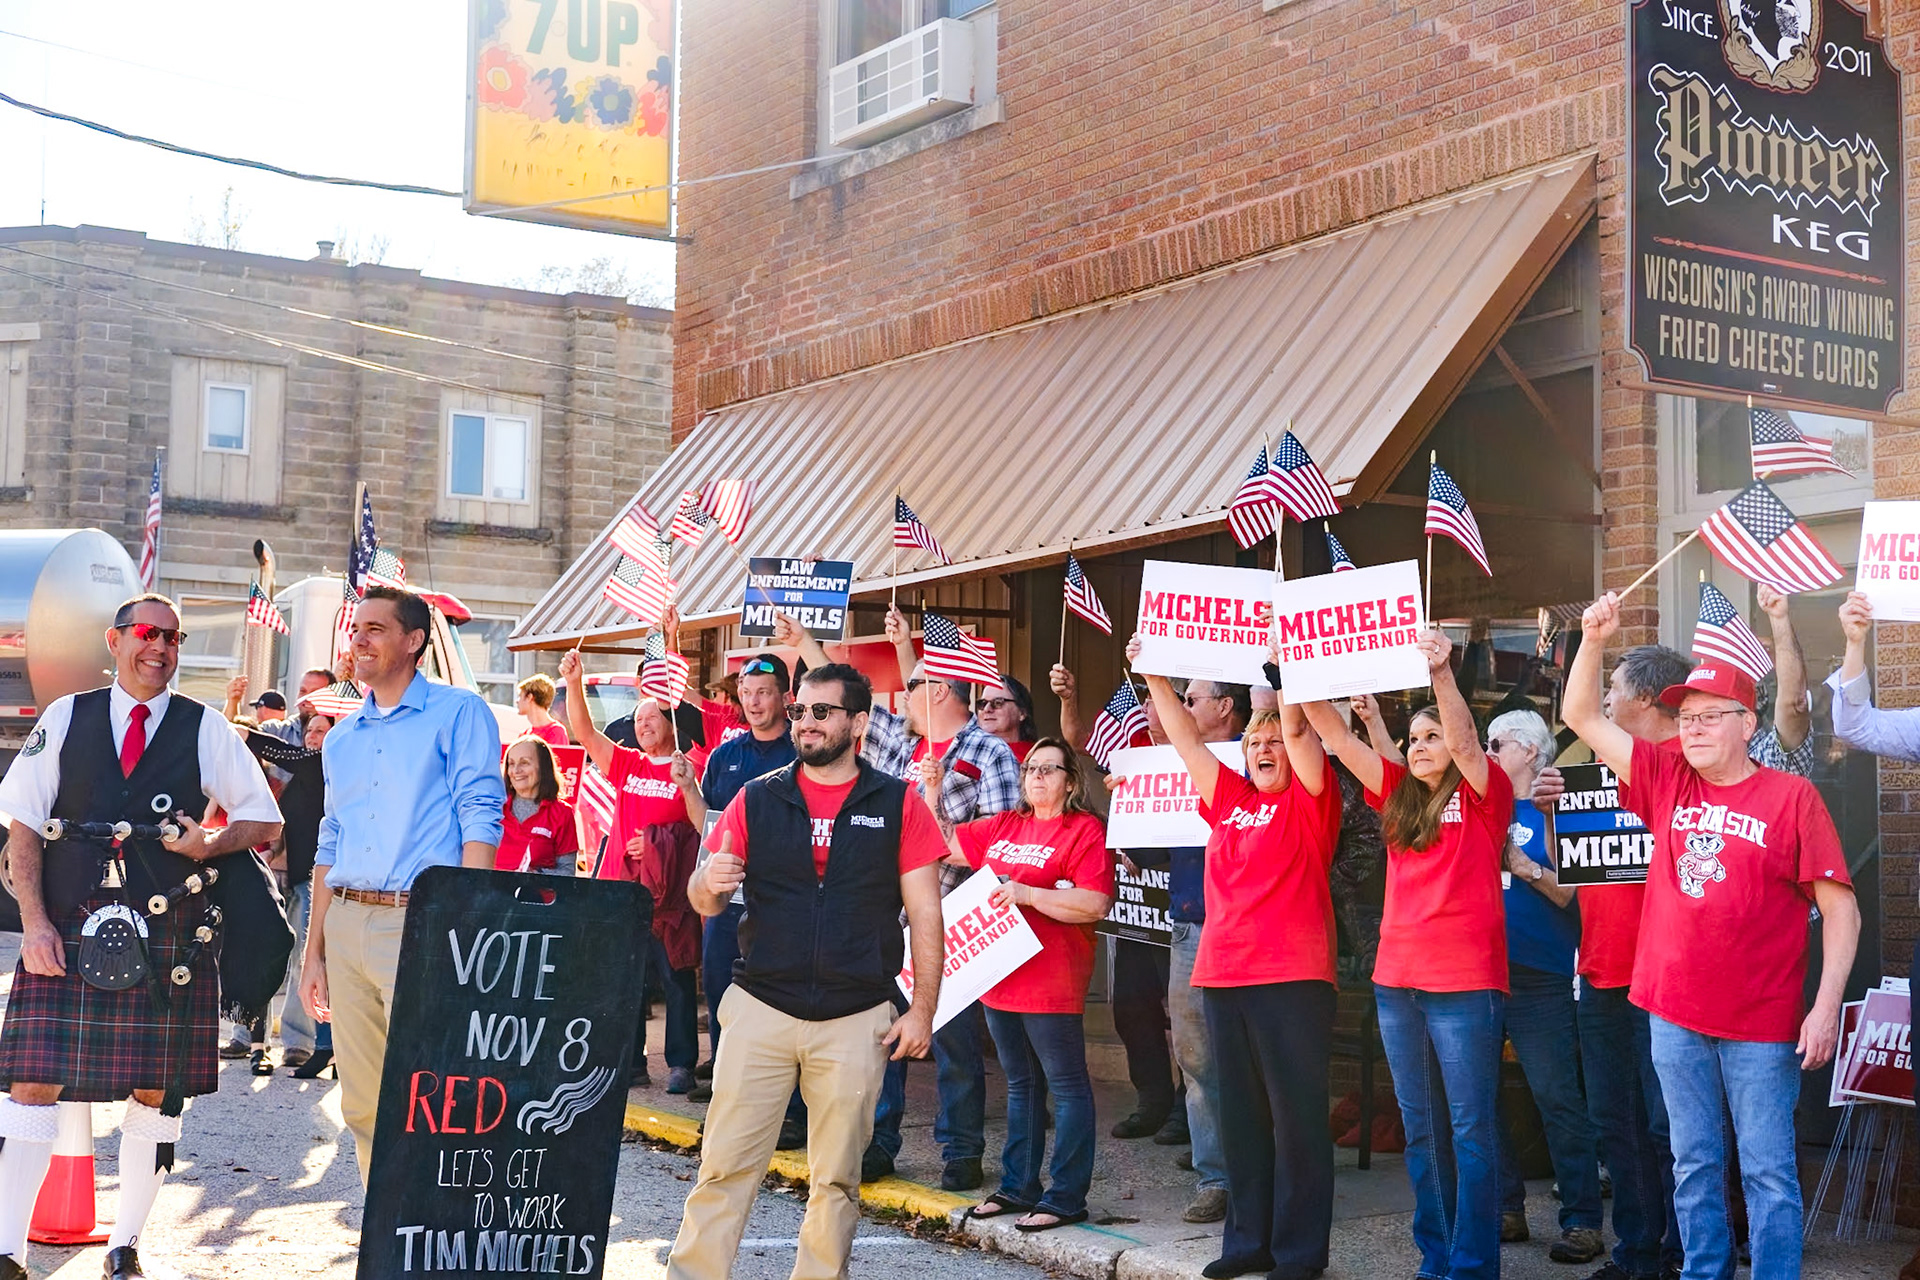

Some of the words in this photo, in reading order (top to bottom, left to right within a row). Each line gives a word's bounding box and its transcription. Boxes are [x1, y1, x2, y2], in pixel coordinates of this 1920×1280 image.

[1824, 42, 1872, 77] 2011
[1653, 69, 1879, 205] Pioneer
[1772, 214, 1870, 261] KEG
[1644, 253, 1756, 317] WISCONSIN'S
[1762, 275, 1820, 328] AWARD
[1825, 286, 1894, 341] WINNING
[1659, 314, 1720, 364] FRIED
[1728, 326, 1805, 378] CHEESE
[1812, 340, 1879, 390] CURDS
[1863, 533, 1920, 562] MIC
[749, 575, 847, 591] ENFORCEMENT
[780, 560, 817, 575] LAW
[1861, 564, 1890, 579] FOR
[784, 592, 803, 602] FOR
[1142, 590, 1273, 629] MICHELS
[1140, 620, 1168, 637] FOR
[1175, 624, 1269, 647] GOVERNOR
[1279, 594, 1418, 644] MICHELS
[1282, 643, 1314, 662] FOR
[1322, 627, 1419, 657] GOVERNOR
[1115, 801, 1145, 814] FOR
[1615, 812, 1643, 827] FOR
[1118, 885, 1145, 903] FOR
[448, 928, 562, 1000] VOTE
[943, 913, 1019, 978] GOVERNOR
[465, 1010, 546, 1067] NOV
[558, 1017, 592, 1073] 8
[1855, 1048, 1888, 1067] FOR
[405, 1070, 508, 1135] RED
[438, 1148, 494, 1188] LET'S
[506, 1148, 547, 1189] GET
[473, 1192, 494, 1229] TO
[503, 1193, 566, 1230] WORK
[395, 1225, 466, 1272] TIM
[475, 1230, 597, 1275] MICHELS
